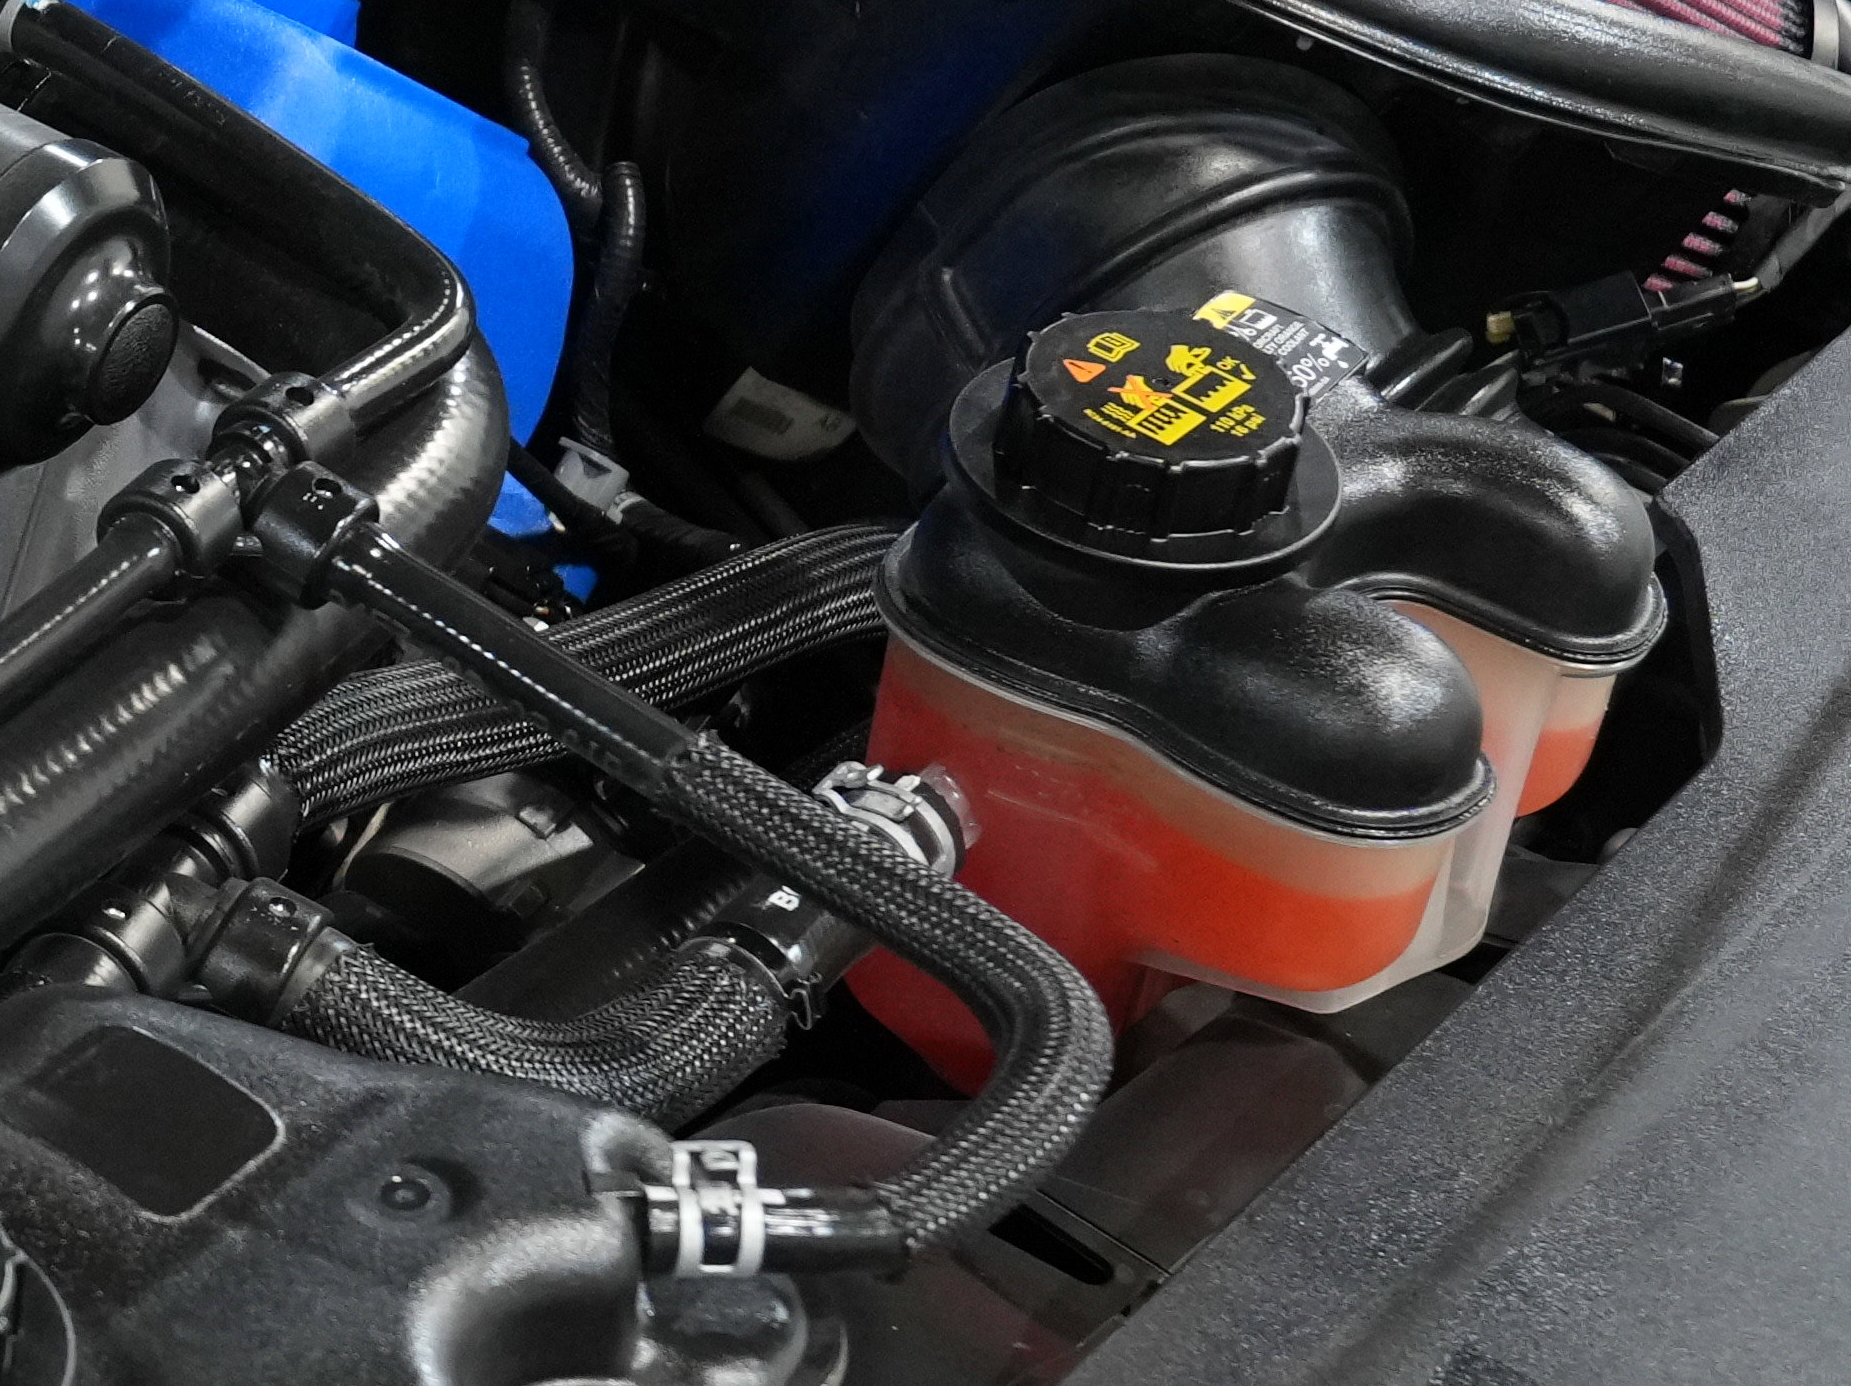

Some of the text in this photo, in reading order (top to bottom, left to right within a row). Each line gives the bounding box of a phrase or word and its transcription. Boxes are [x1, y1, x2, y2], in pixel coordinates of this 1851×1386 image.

[1277, 328, 1310, 356] COOLANT
[1216, 356, 1241, 370] OK
[1210, 417, 1236, 432] 110
